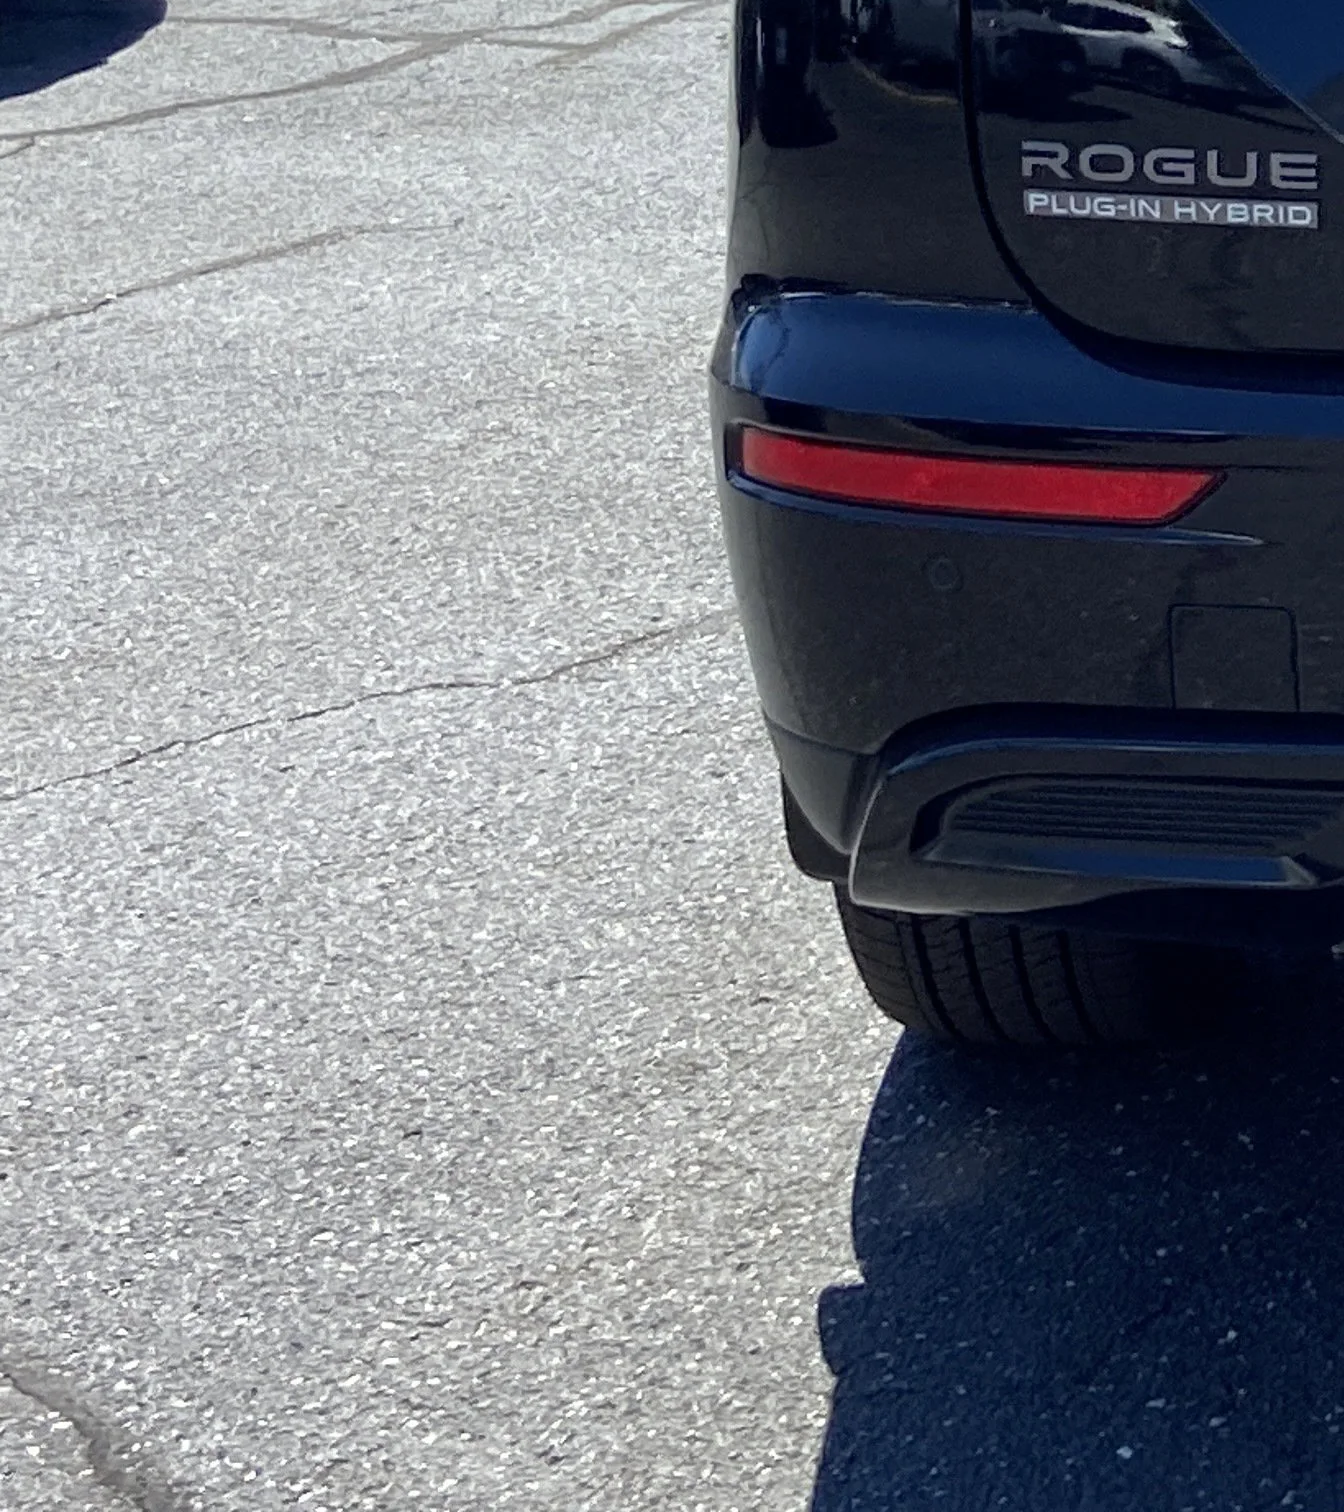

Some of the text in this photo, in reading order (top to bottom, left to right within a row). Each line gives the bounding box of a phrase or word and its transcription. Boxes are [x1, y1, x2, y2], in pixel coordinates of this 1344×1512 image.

[1021, 140, 1319, 190] ROGUE
[1027, 192, 1313, 225] PLUG-IN HYBRID
